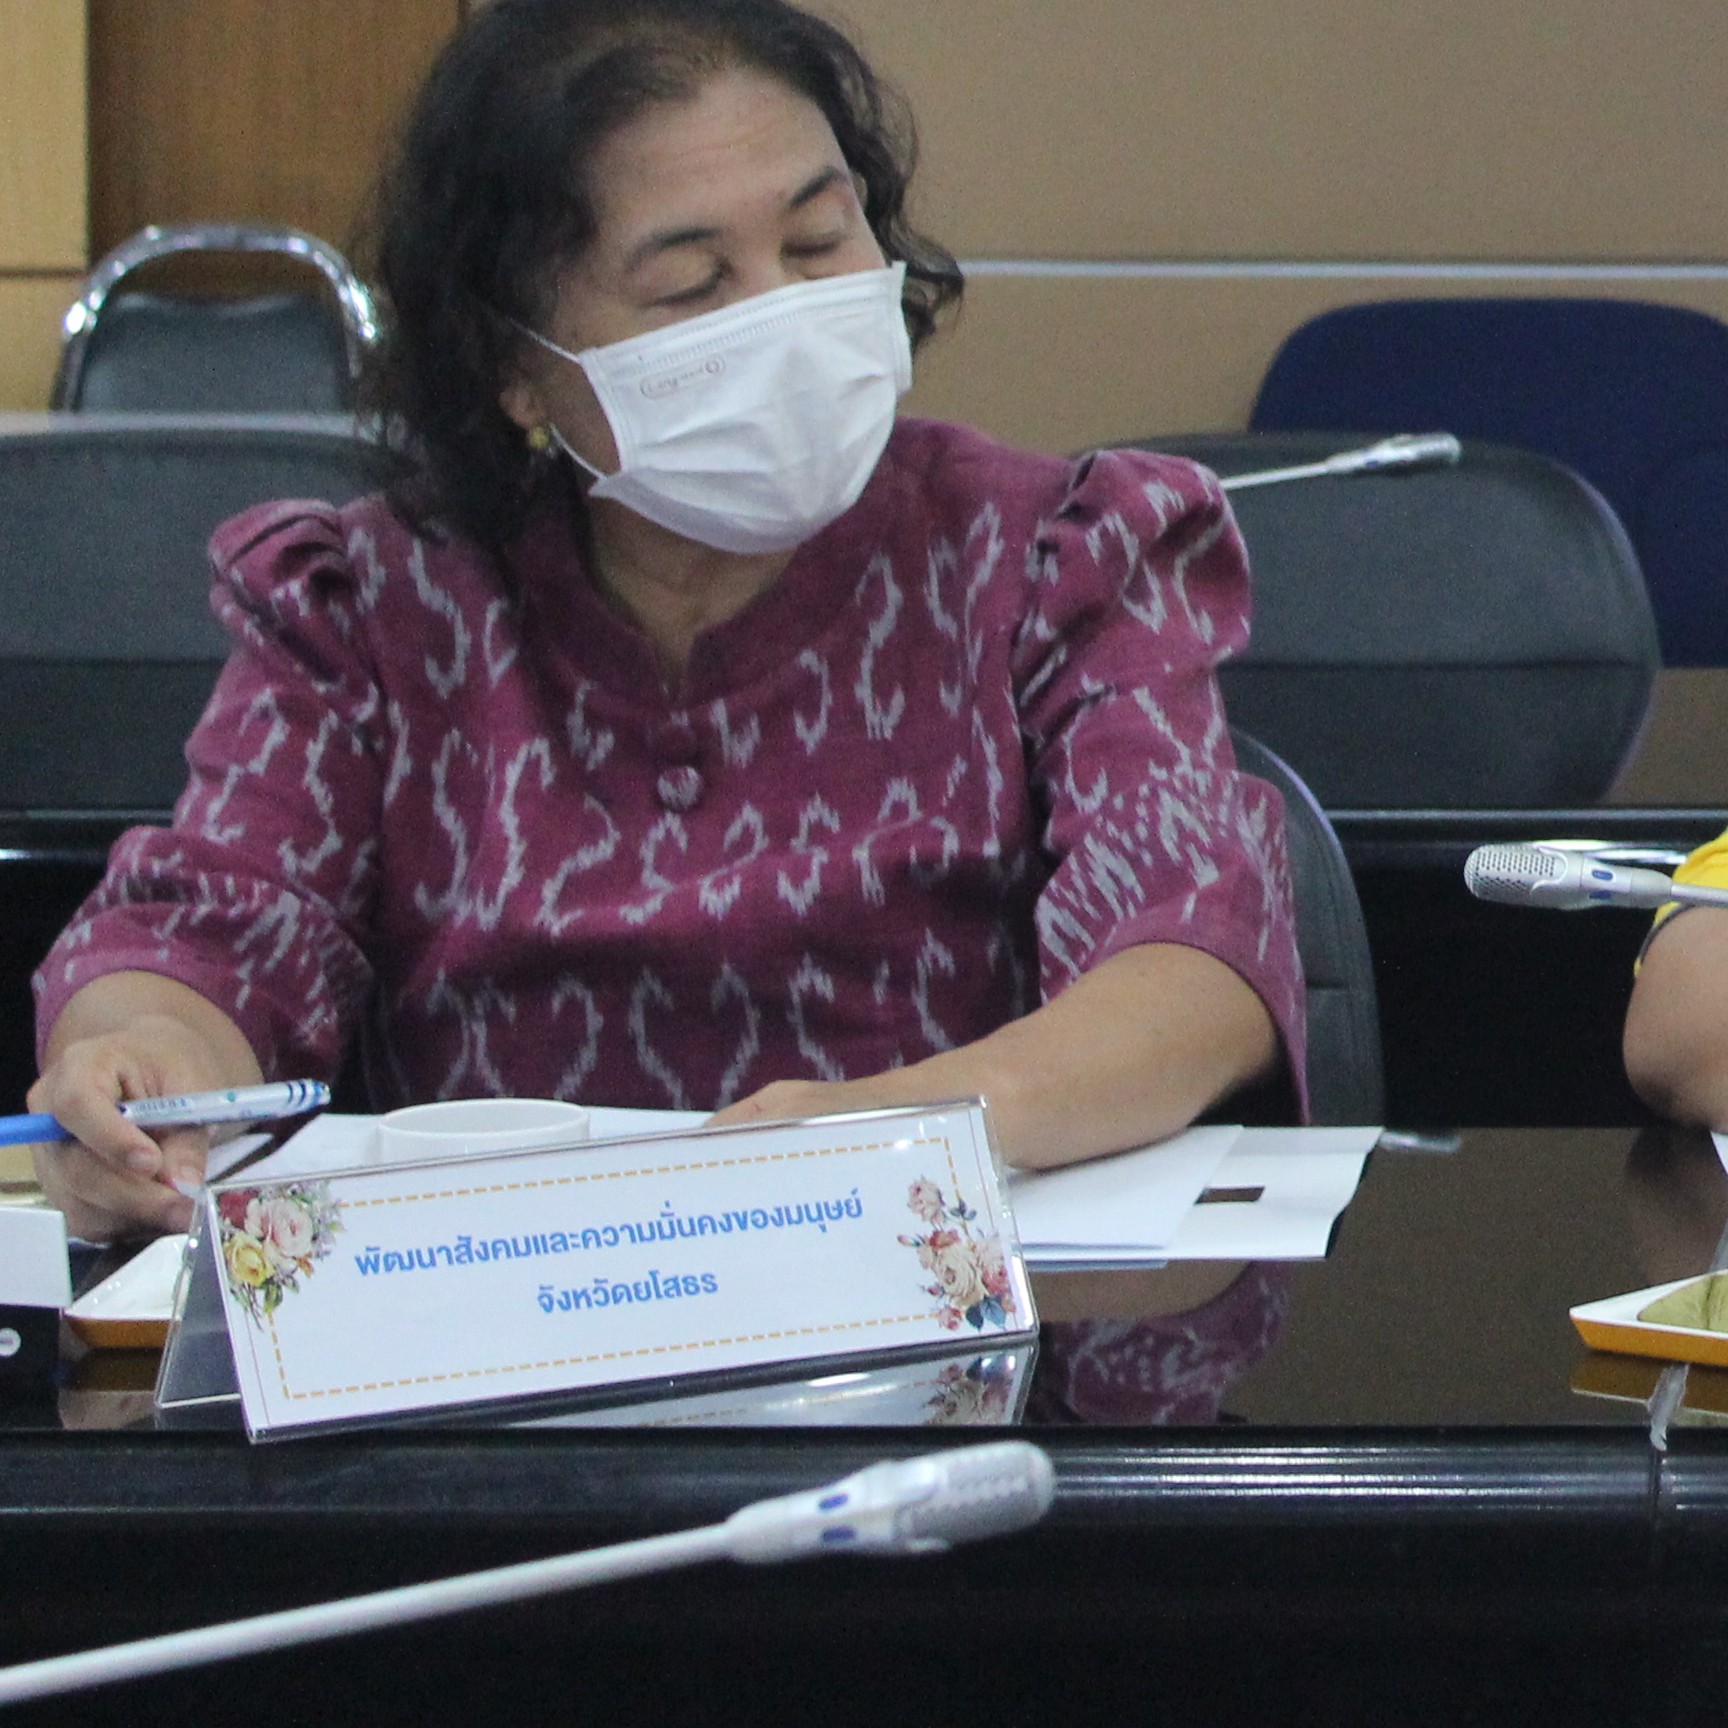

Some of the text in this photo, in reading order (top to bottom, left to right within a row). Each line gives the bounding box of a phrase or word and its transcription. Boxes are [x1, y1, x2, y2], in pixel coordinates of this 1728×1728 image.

[354, 1188, 864, 1276] พัฒนาสังคมและความมั่นคงของมนุษย์
[536, 1269, 720, 1314] จังหวัดยโสธร
